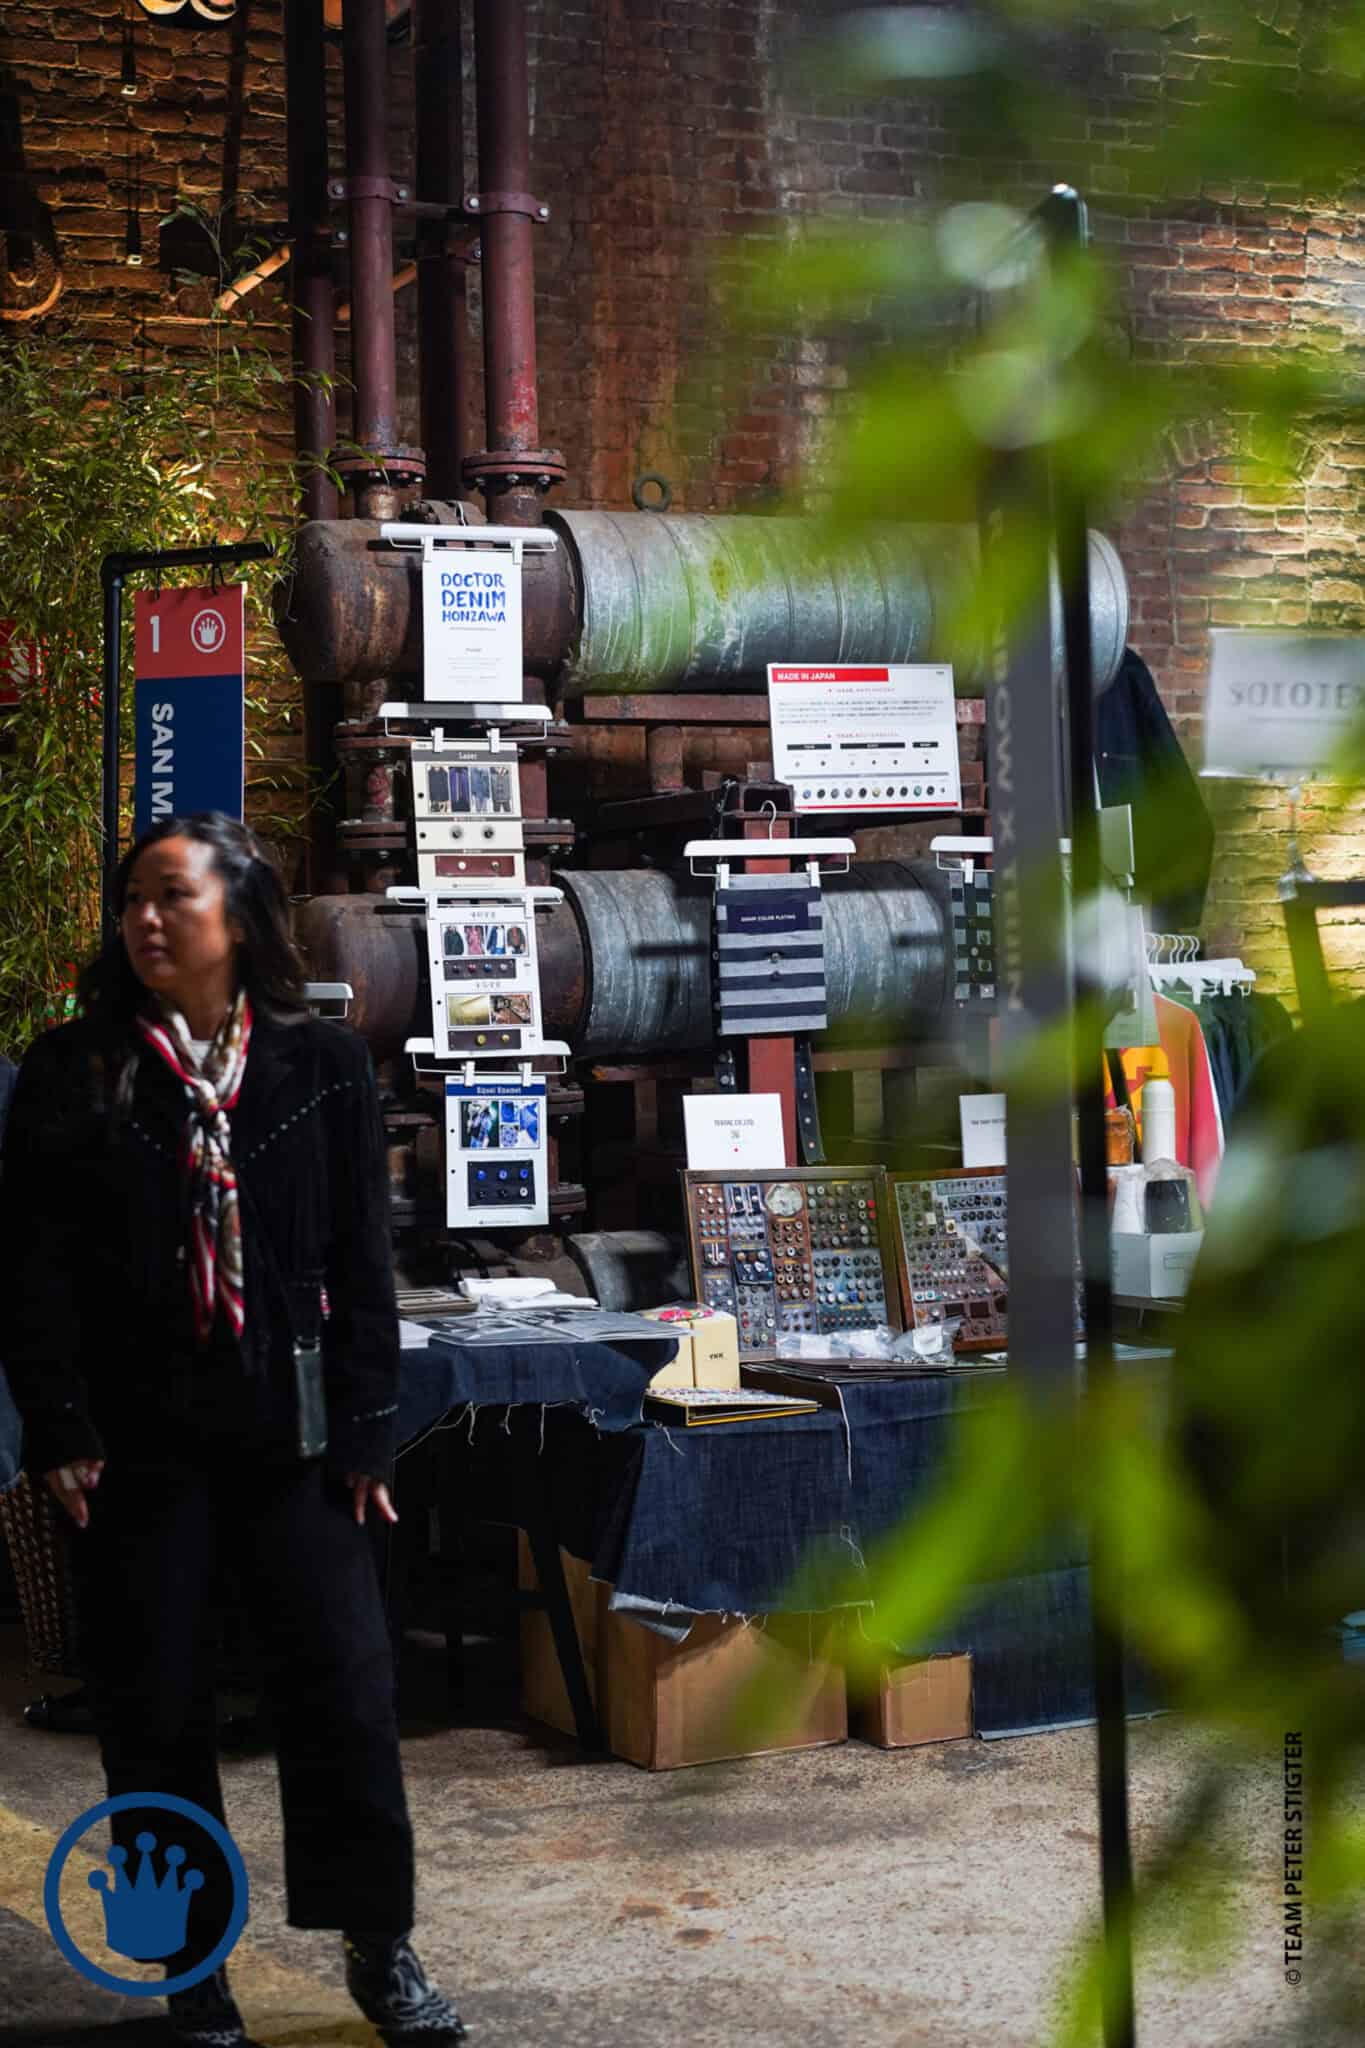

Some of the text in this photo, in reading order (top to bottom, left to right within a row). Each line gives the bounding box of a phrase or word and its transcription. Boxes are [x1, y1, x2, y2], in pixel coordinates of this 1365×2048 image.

[440, 572, 505, 588] DOCTOR
[441, 590, 506, 609] DENIM
[442, 610, 506, 623] HONZAWA
[150, 615, 160, 653] 1
[777, 672, 836, 681] MADE IN JAPAN
[151, 703, 174, 824] SAN M
